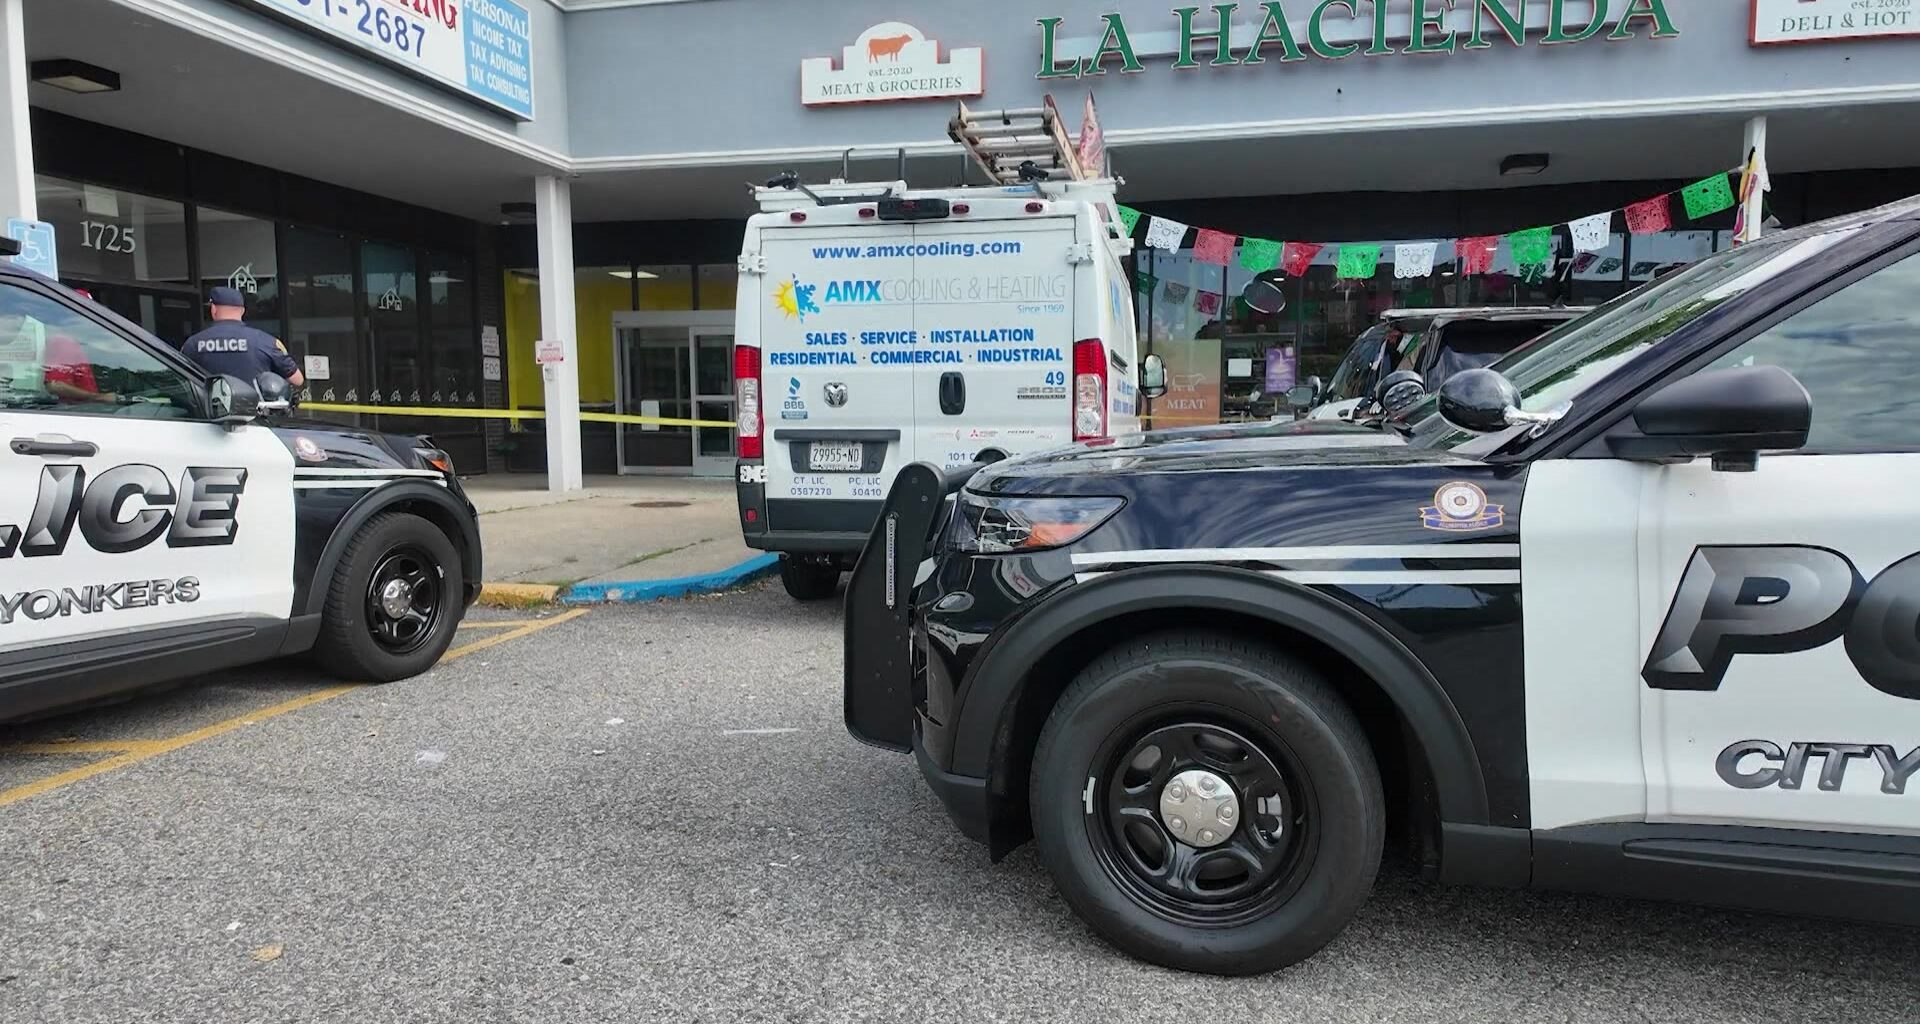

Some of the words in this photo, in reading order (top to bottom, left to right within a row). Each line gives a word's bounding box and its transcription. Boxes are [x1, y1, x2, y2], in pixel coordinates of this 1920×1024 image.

[297, 0, 425, 58] -2687
[1781, 16, 1832, 32] DELI
[1840, 12, 1855, 28] &
[1864, 11, 1911, 26] HOT
[472, 19, 505, 50] INCOME
[507, 37, 523, 59] TAX
[1035, 13, 1145, 80] LA
[1172, 0, 1681, 70] HACIENDA
[470, 40, 487, 64] TAX
[490, 51, 527, 82] ADVISING
[470, 63, 486, 85] TAX
[487, 71, 530, 105] CONSULTING
[821, 83, 862, 97] MEAT
[866, 81, 875, 94] &
[880, 77, 962, 92] GROCERIES
[80, 220, 136, 254] 1725
[812, 240, 1021, 260] www.amxcooling.com
[967, 277, 981, 300] &
[987, 274, 1066, 299] HEATING
[1017, 304, 1040, 313] Since
[198, 338, 248, 353] POLICE
[806, 332, 847, 345] SALES
[860, 331, 917, 345] SERVICE
[930, 328, 1034, 343] INSTALLATION
[770, 351, 857, 365] RESIDENTIAL
[870, 350, 963, 364] COMMERCIAL
[977, 348, 1063, 362] INDUSTRIAL
[1045, 371, 1065, 386] 49
[784, 401, 805, 410] BBB
[1167, 399, 1206, 410] MEAT
[948, 452, 966, 461] 101
[0, 575, 200, 624] YONKERS
[1715, 739, 1920, 796] CITY
